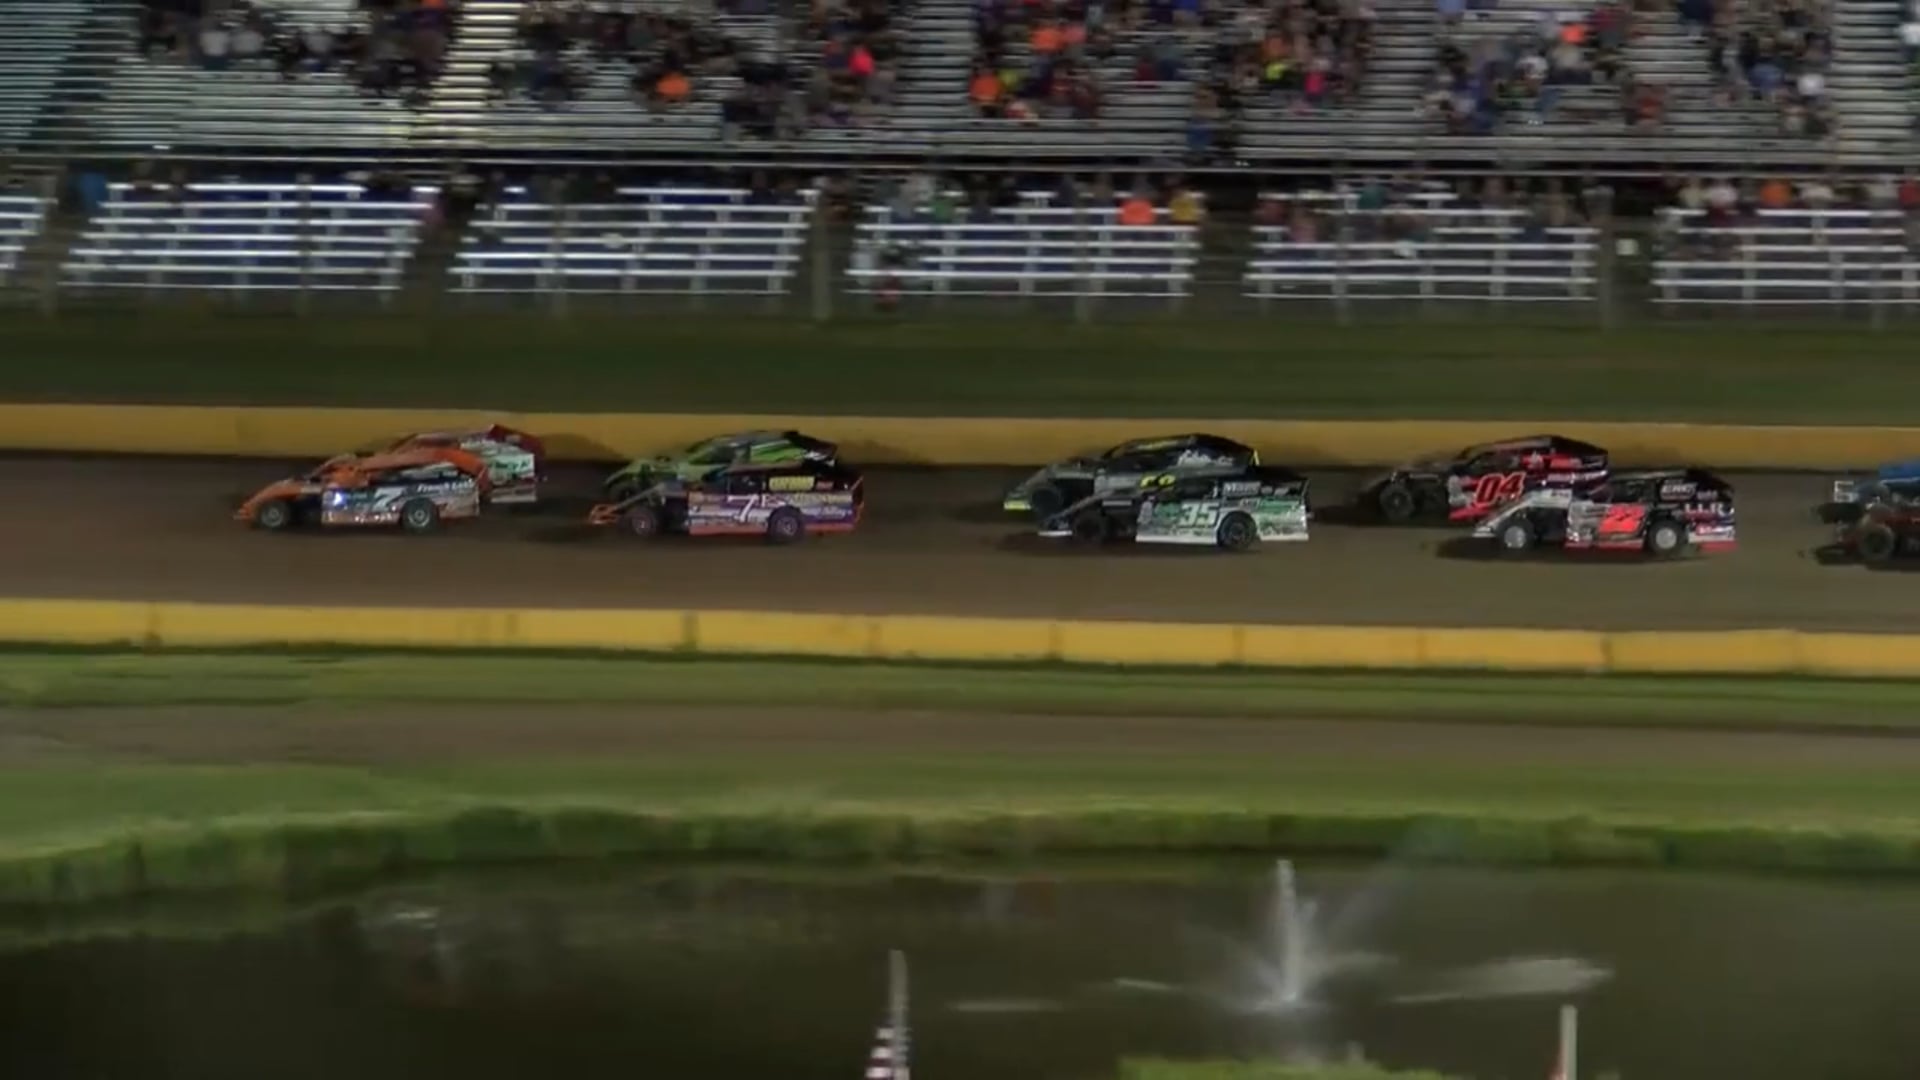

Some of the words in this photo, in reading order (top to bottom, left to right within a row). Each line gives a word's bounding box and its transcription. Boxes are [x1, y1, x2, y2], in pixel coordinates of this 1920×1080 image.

[371, 486, 405, 512] 7
[1474, 472, 1527, 504] 04
[1177, 502, 1220, 528] 35
[1598, 503, 1647, 533] 22
